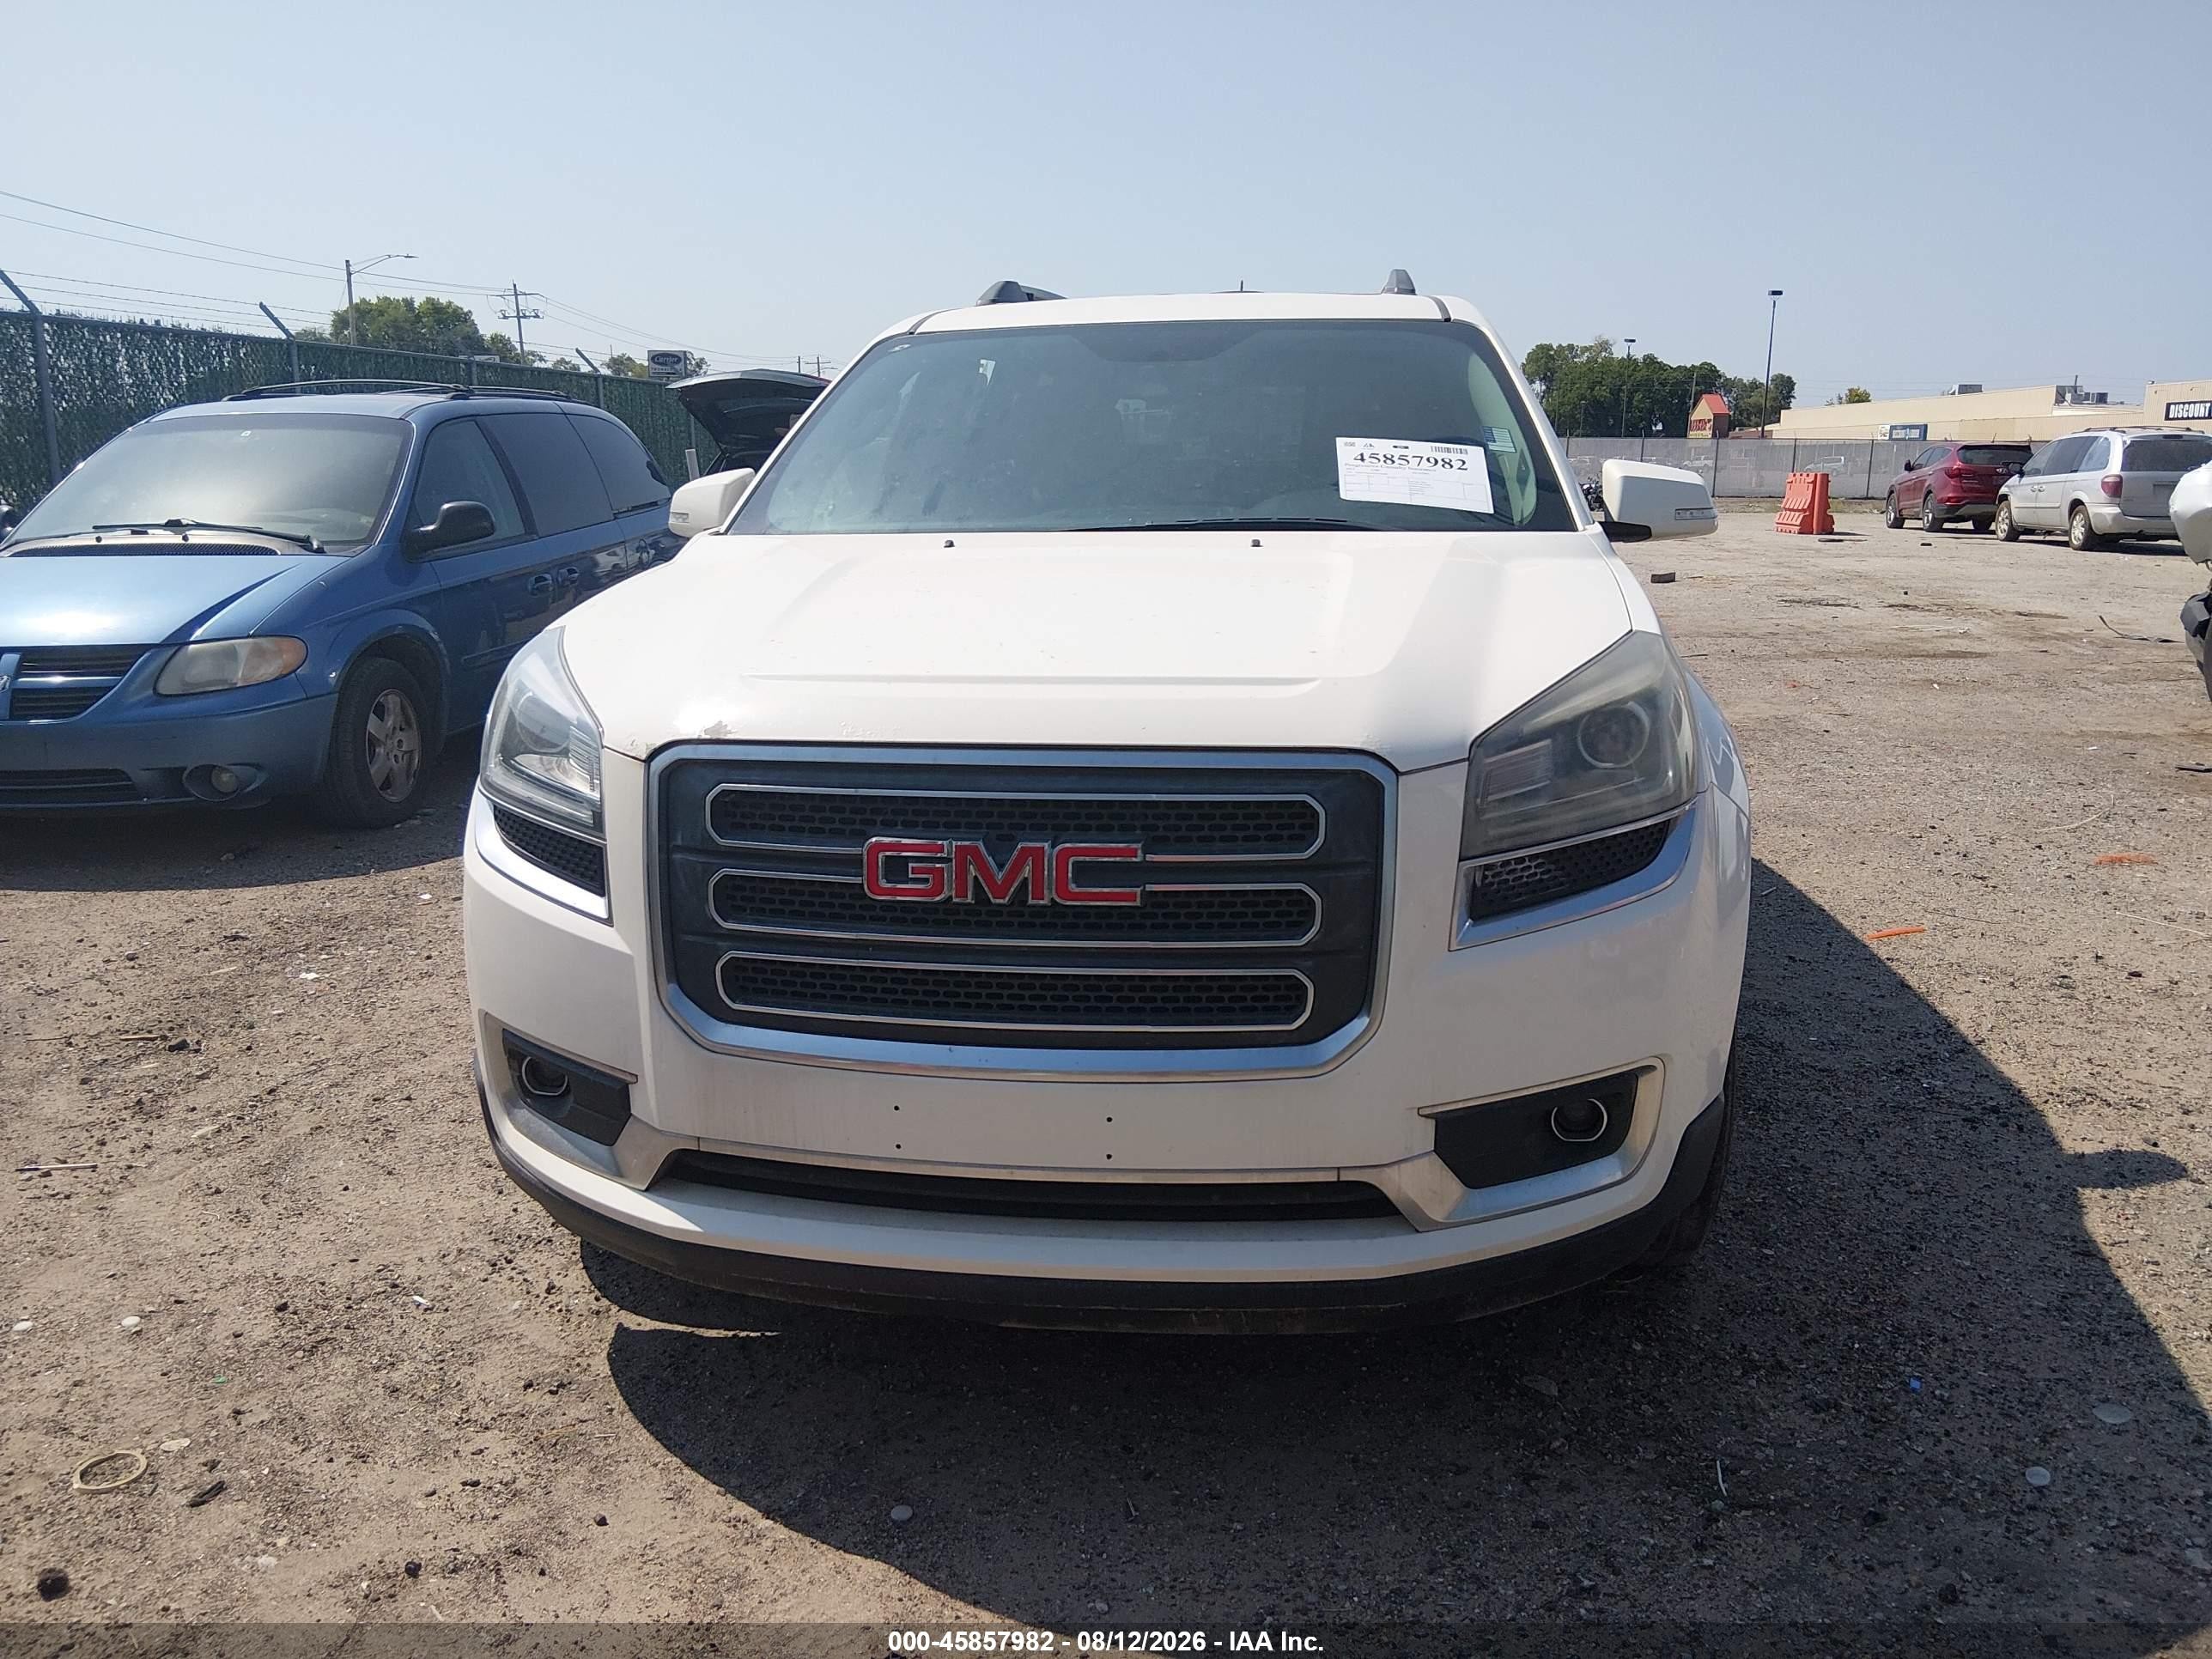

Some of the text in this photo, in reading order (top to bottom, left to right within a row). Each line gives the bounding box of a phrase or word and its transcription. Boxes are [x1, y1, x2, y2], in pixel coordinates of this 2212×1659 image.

[653, 356, 679, 364] Carrier
[2168, 403, 2211, 418] DISCOUNT
[1353, 452, 1468, 471] 45857982
[862, 836, 1143, 906] GMC
